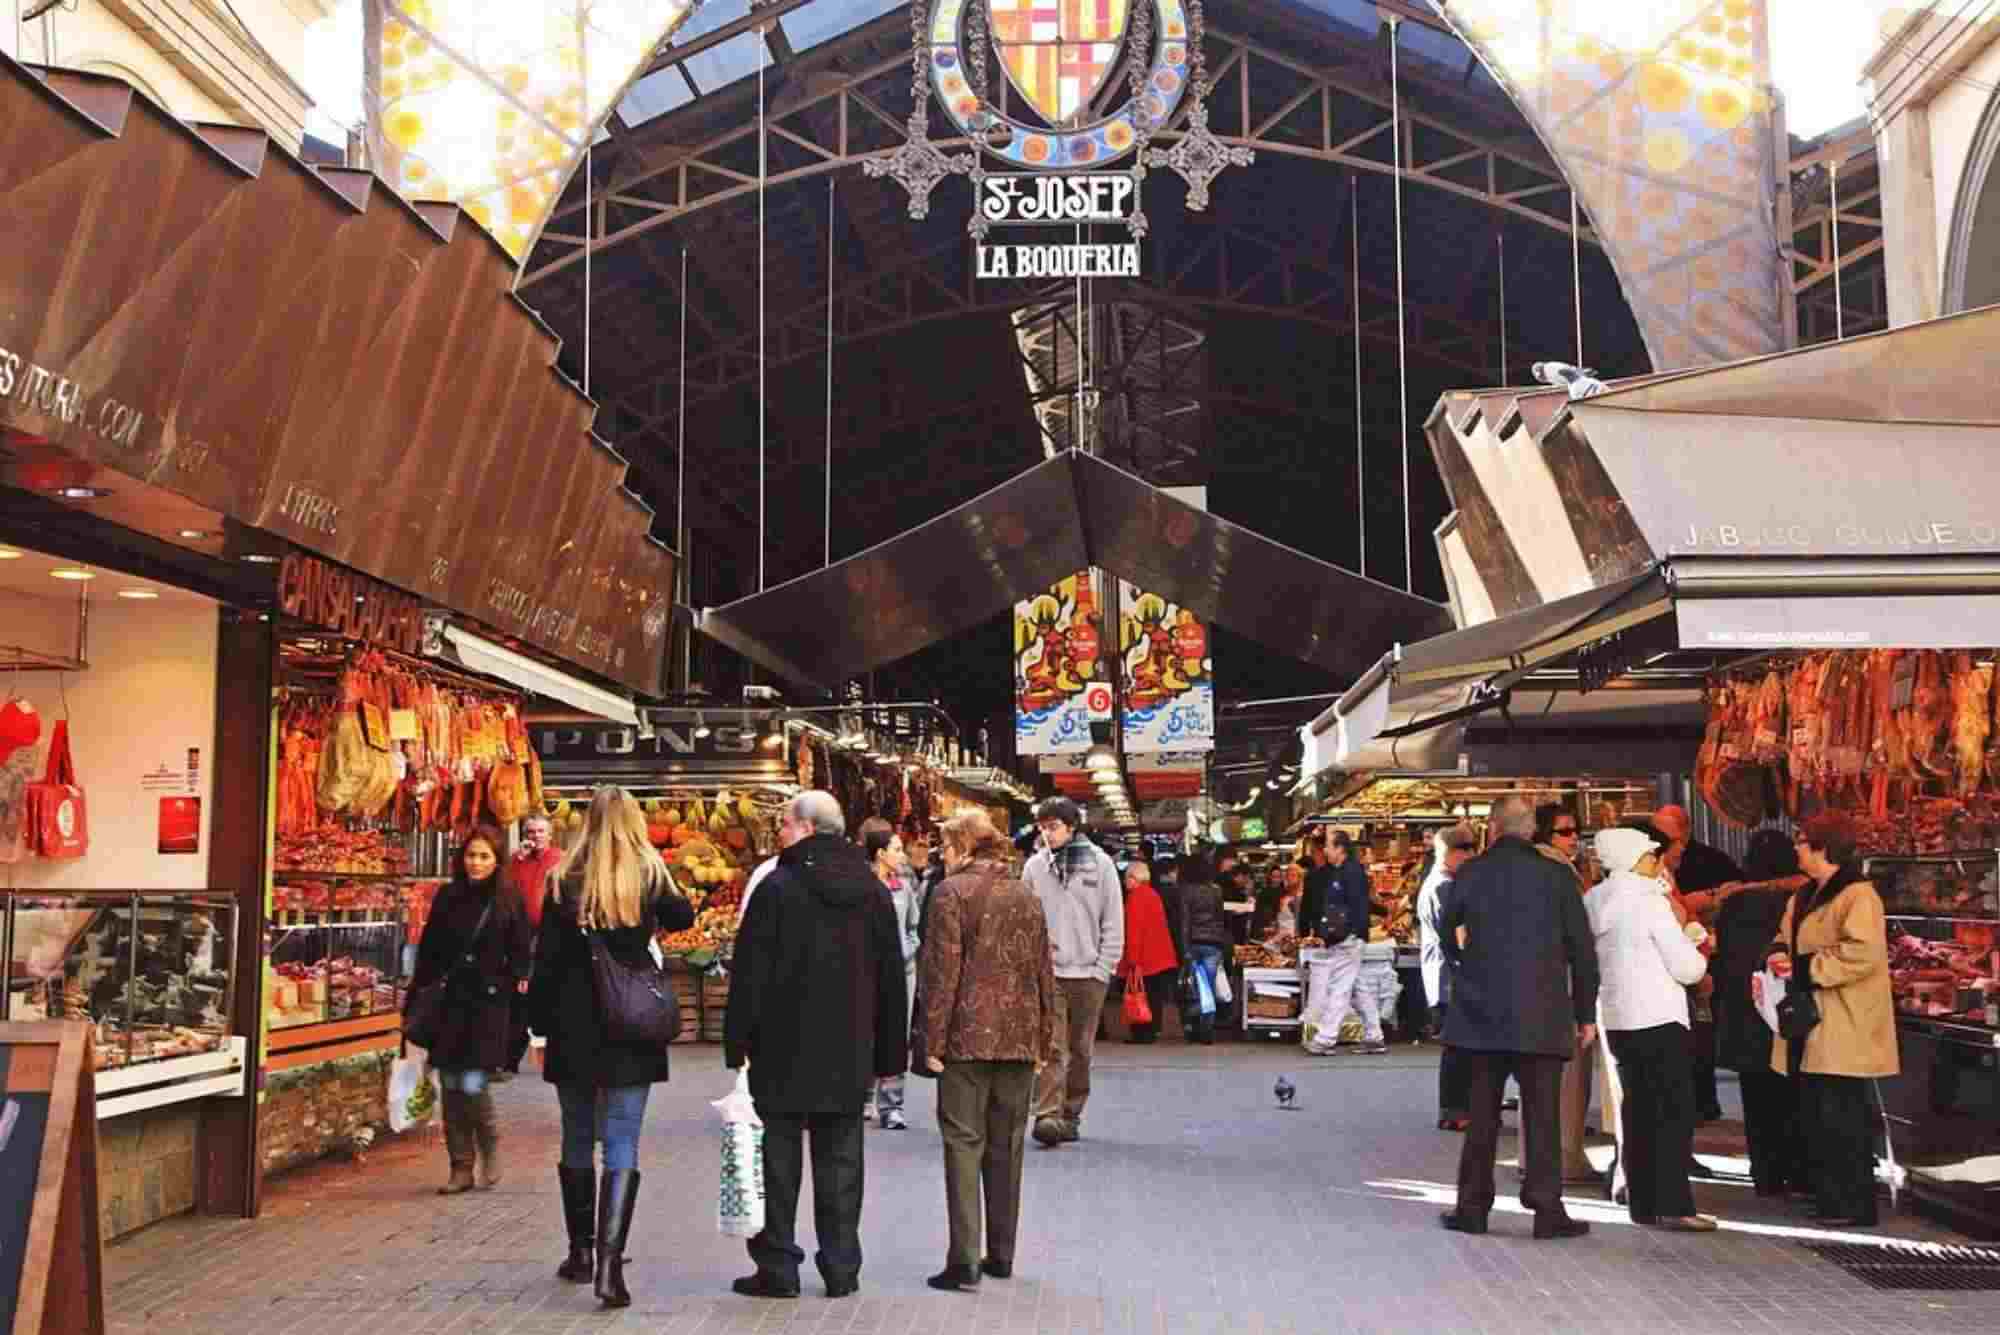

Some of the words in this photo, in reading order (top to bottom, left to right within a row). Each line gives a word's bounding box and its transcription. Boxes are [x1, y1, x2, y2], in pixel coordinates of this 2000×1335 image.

[1019, 175, 1134, 219] JOSEP
[976, 245, 1010, 278] LA
[1016, 243, 1140, 277] BOQUERIA
[1094, 690, 1106, 707] 6
[540, 726, 756, 754] PONS
